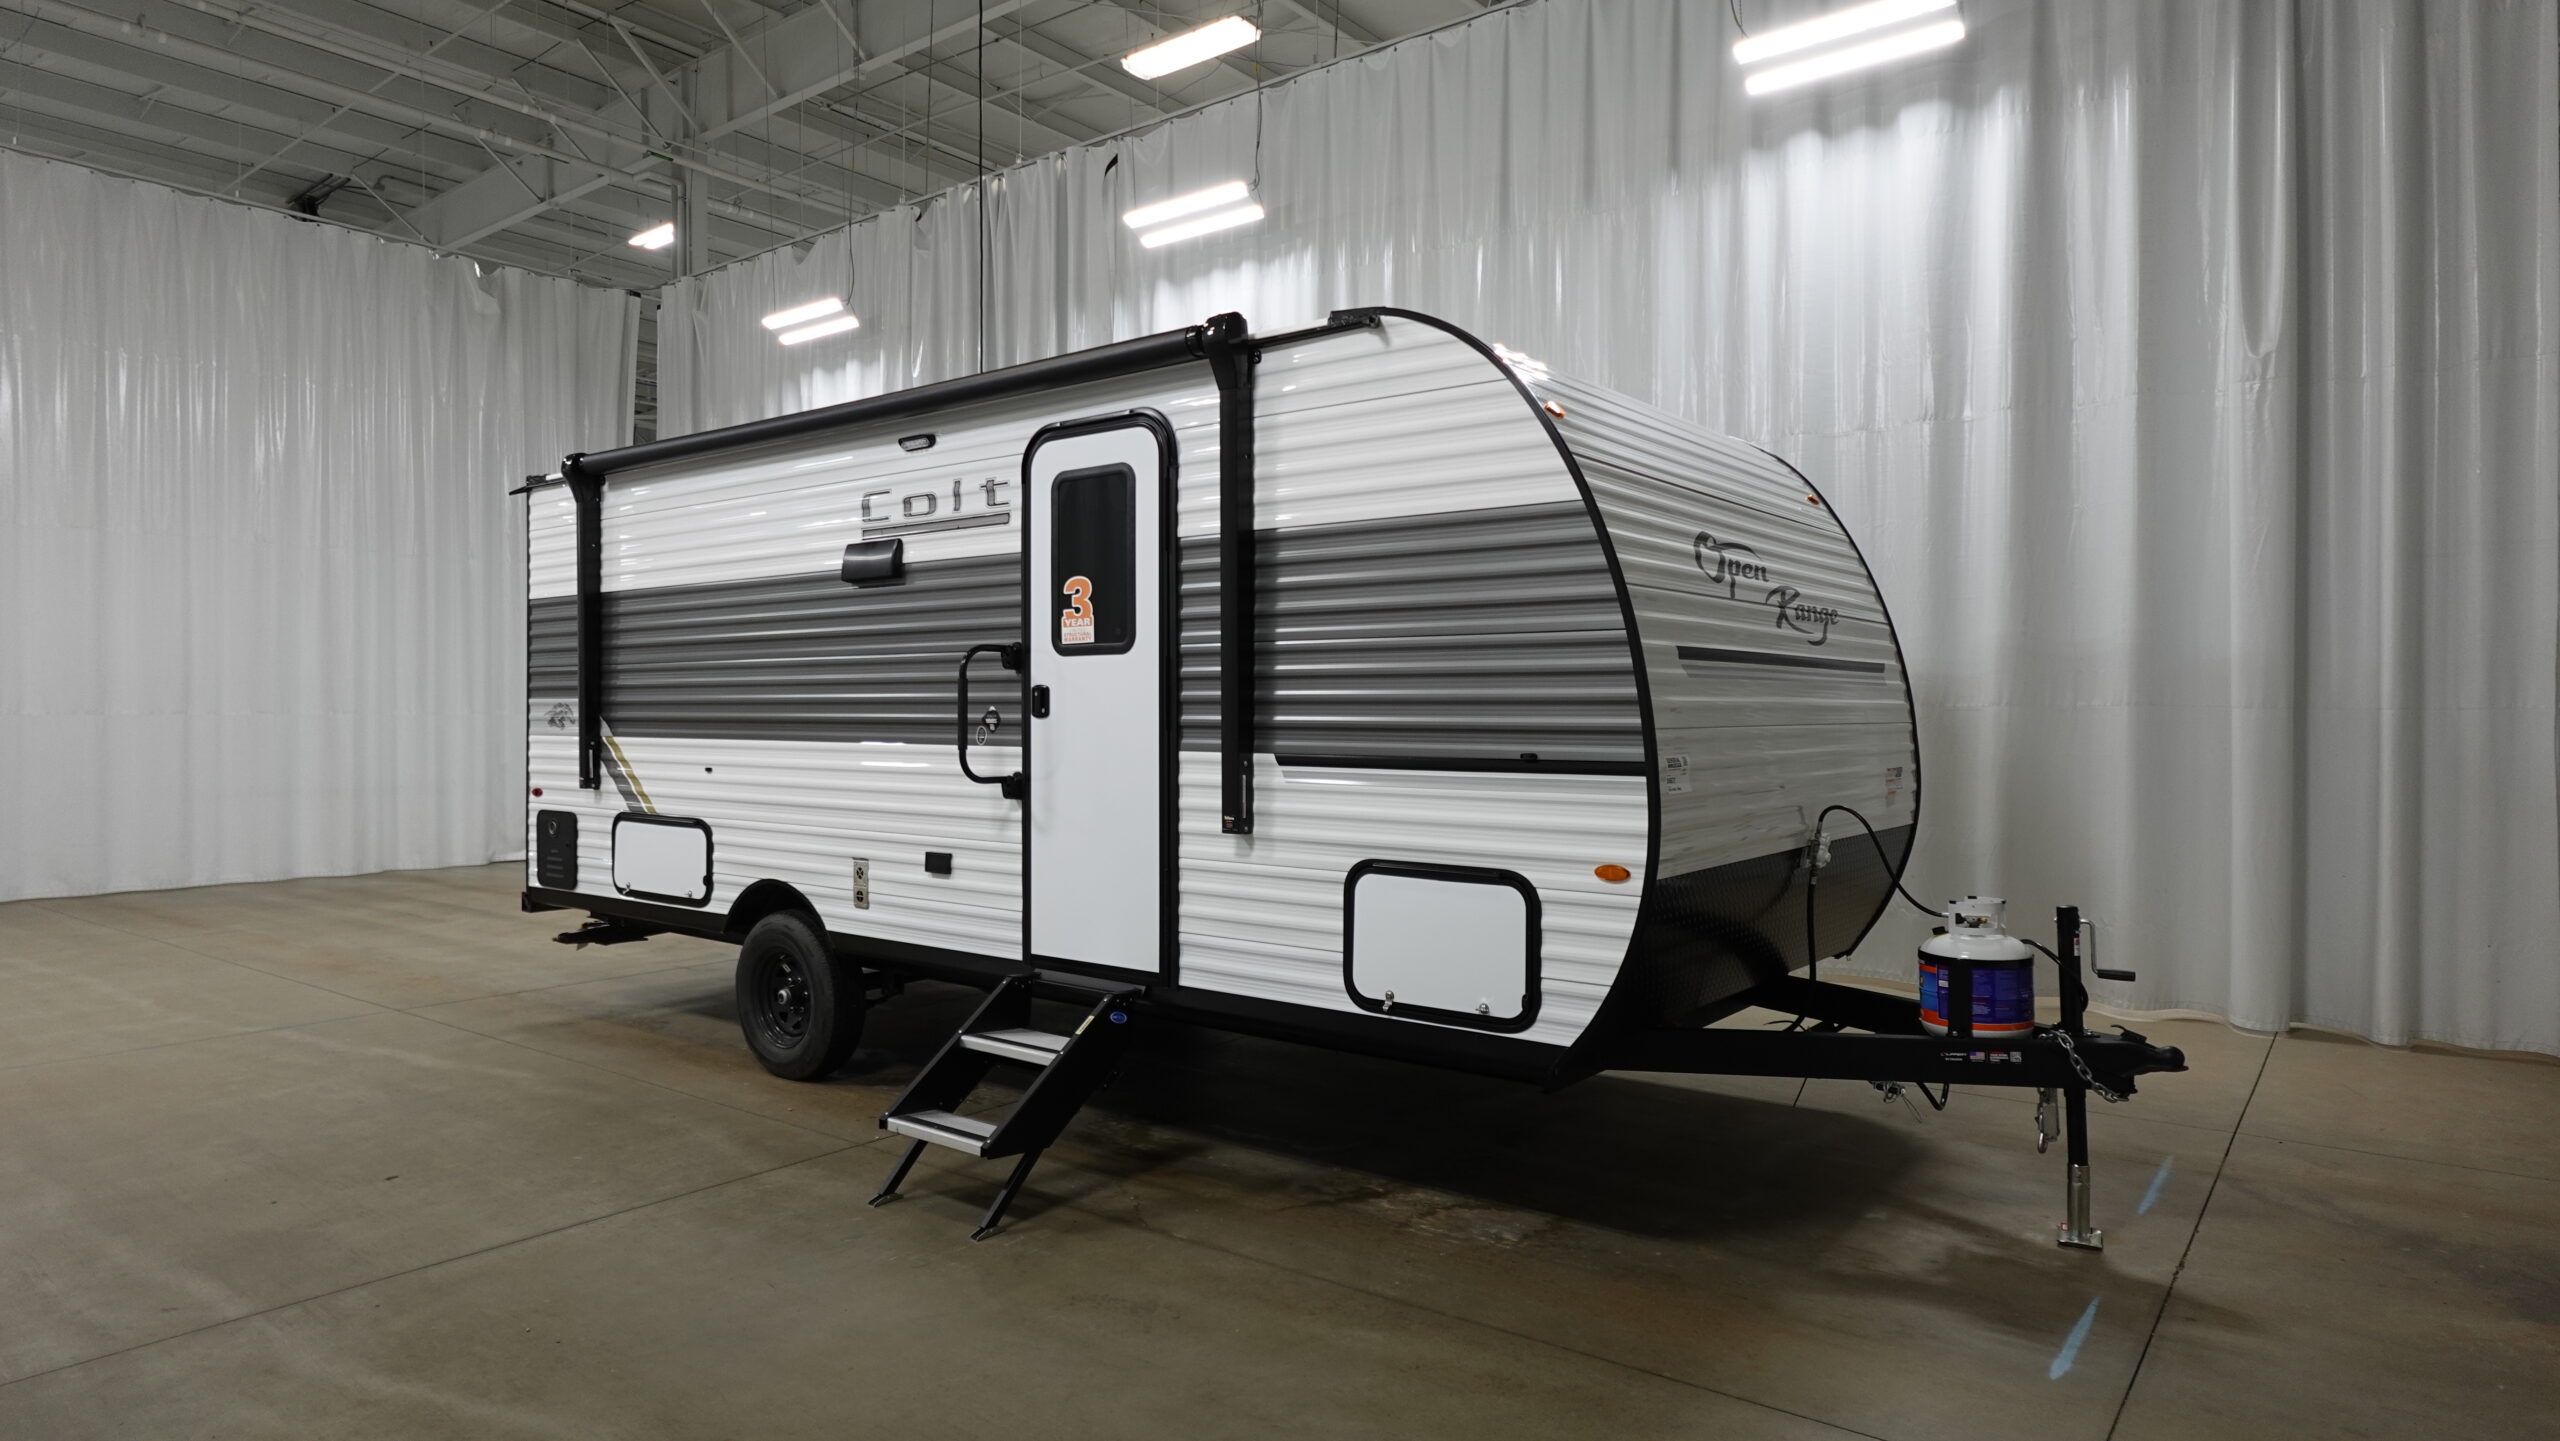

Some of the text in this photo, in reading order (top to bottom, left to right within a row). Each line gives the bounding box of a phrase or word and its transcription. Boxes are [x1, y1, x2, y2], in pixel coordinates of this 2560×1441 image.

[862, 479, 1009, 522] Colt
[1693, 531, 1770, 600] Open
[1064, 577, 1092, 618] 3
[1766, 585, 1840, 646] Range
[1065, 618, 1090, 626] YEAR
